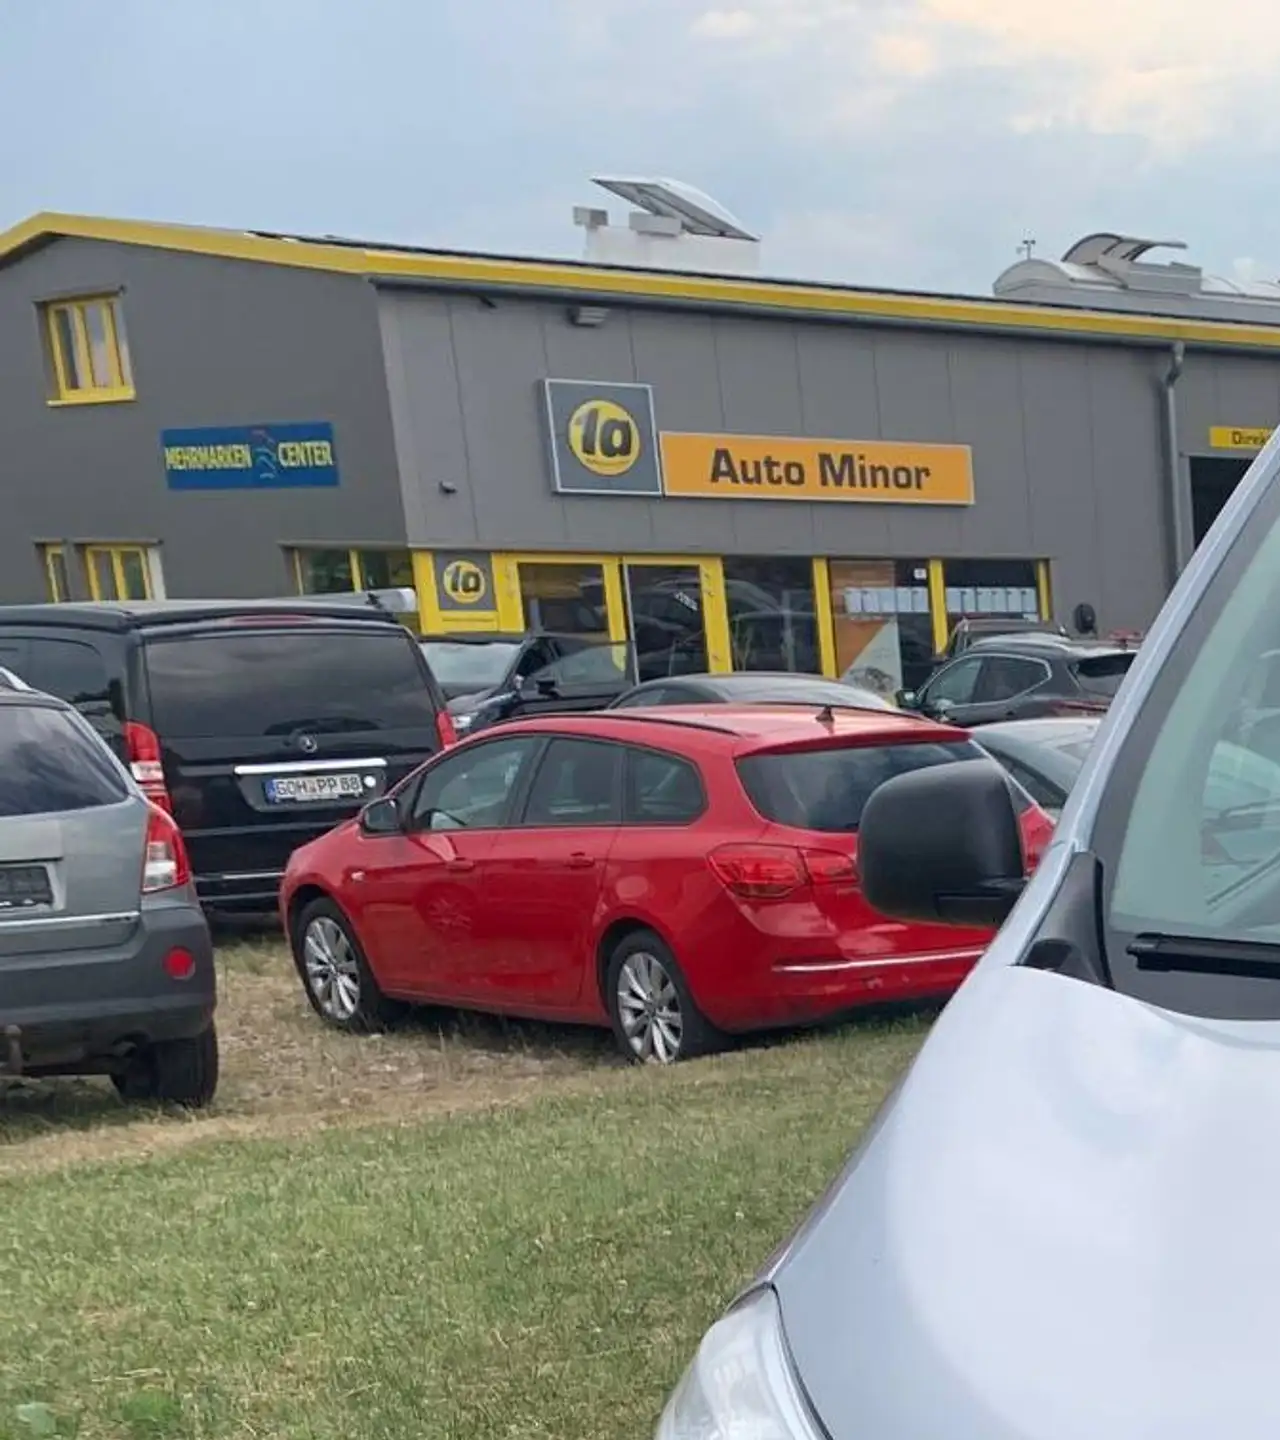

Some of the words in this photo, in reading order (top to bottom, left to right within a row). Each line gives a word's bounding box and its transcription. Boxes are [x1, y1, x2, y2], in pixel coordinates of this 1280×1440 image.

[277, 439, 334, 468] CENTER
[710, 447, 805, 486] Auto
[817, 451, 931, 491] Minor
